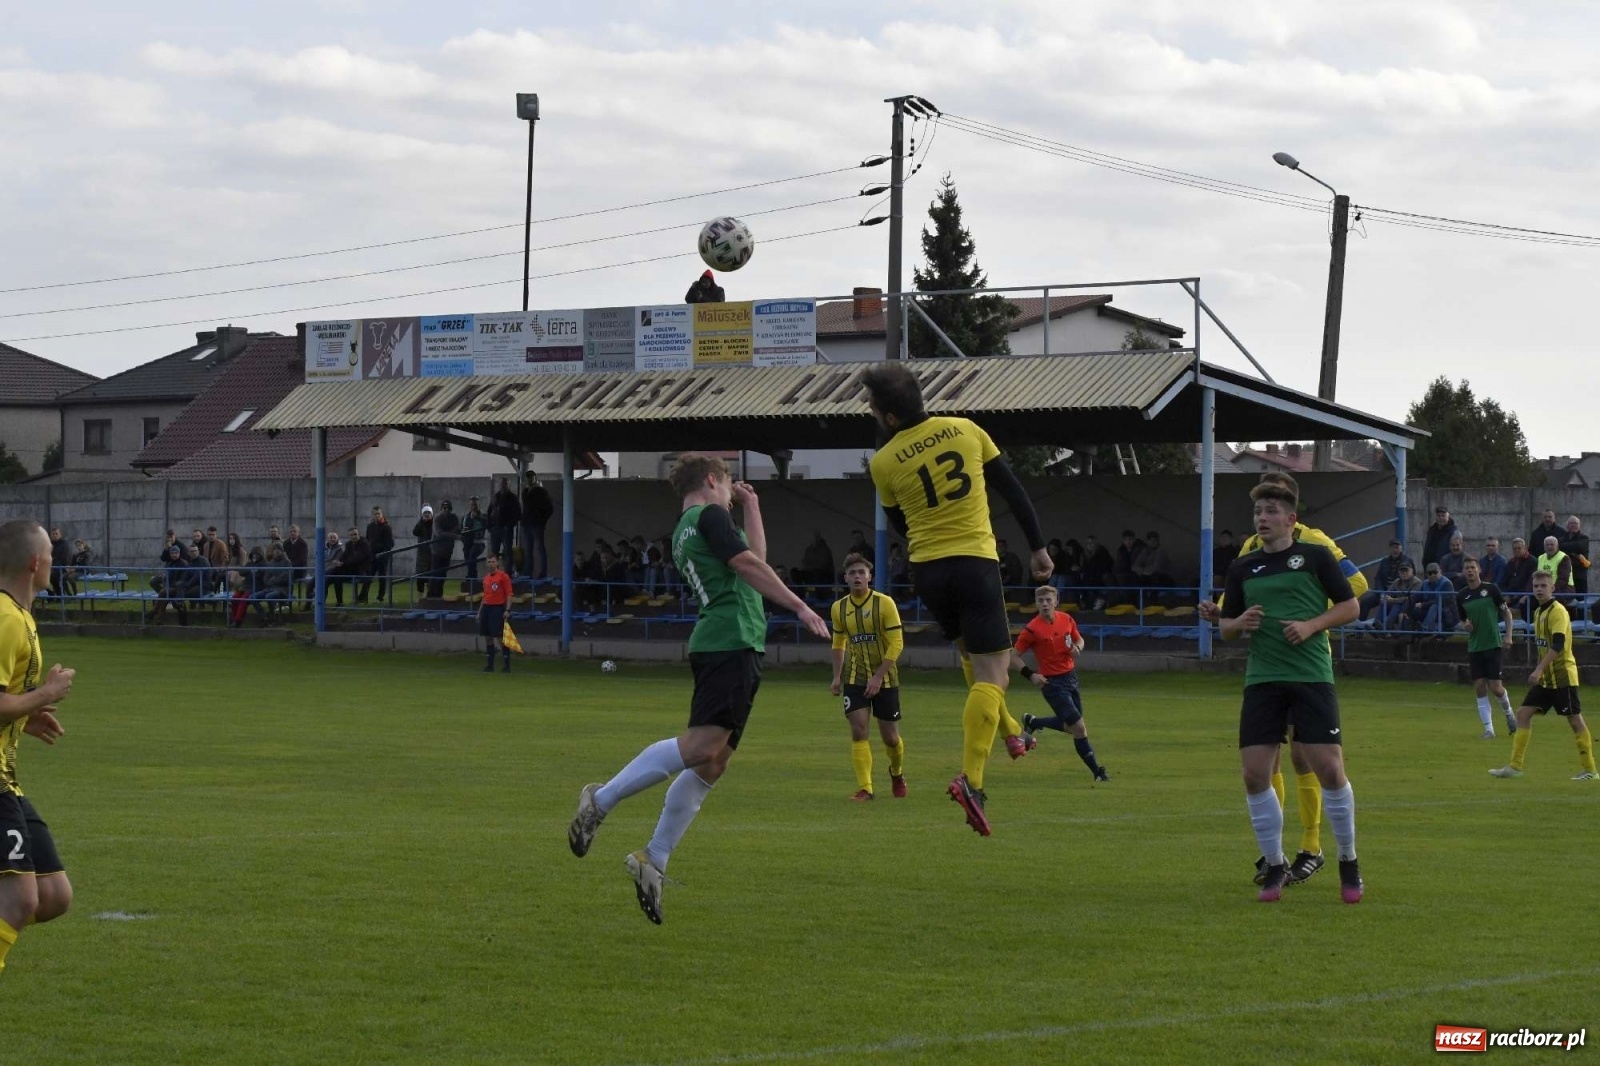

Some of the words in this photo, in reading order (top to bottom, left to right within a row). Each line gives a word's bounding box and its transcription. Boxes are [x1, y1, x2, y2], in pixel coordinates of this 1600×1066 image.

[548, 319, 577, 335] terra
[698, 309, 750, 322] Matuszek
[895, 426, 964, 464] LUBOMIA
[917, 450, 972, 508] 13
[6, 829, 25, 860] 2
